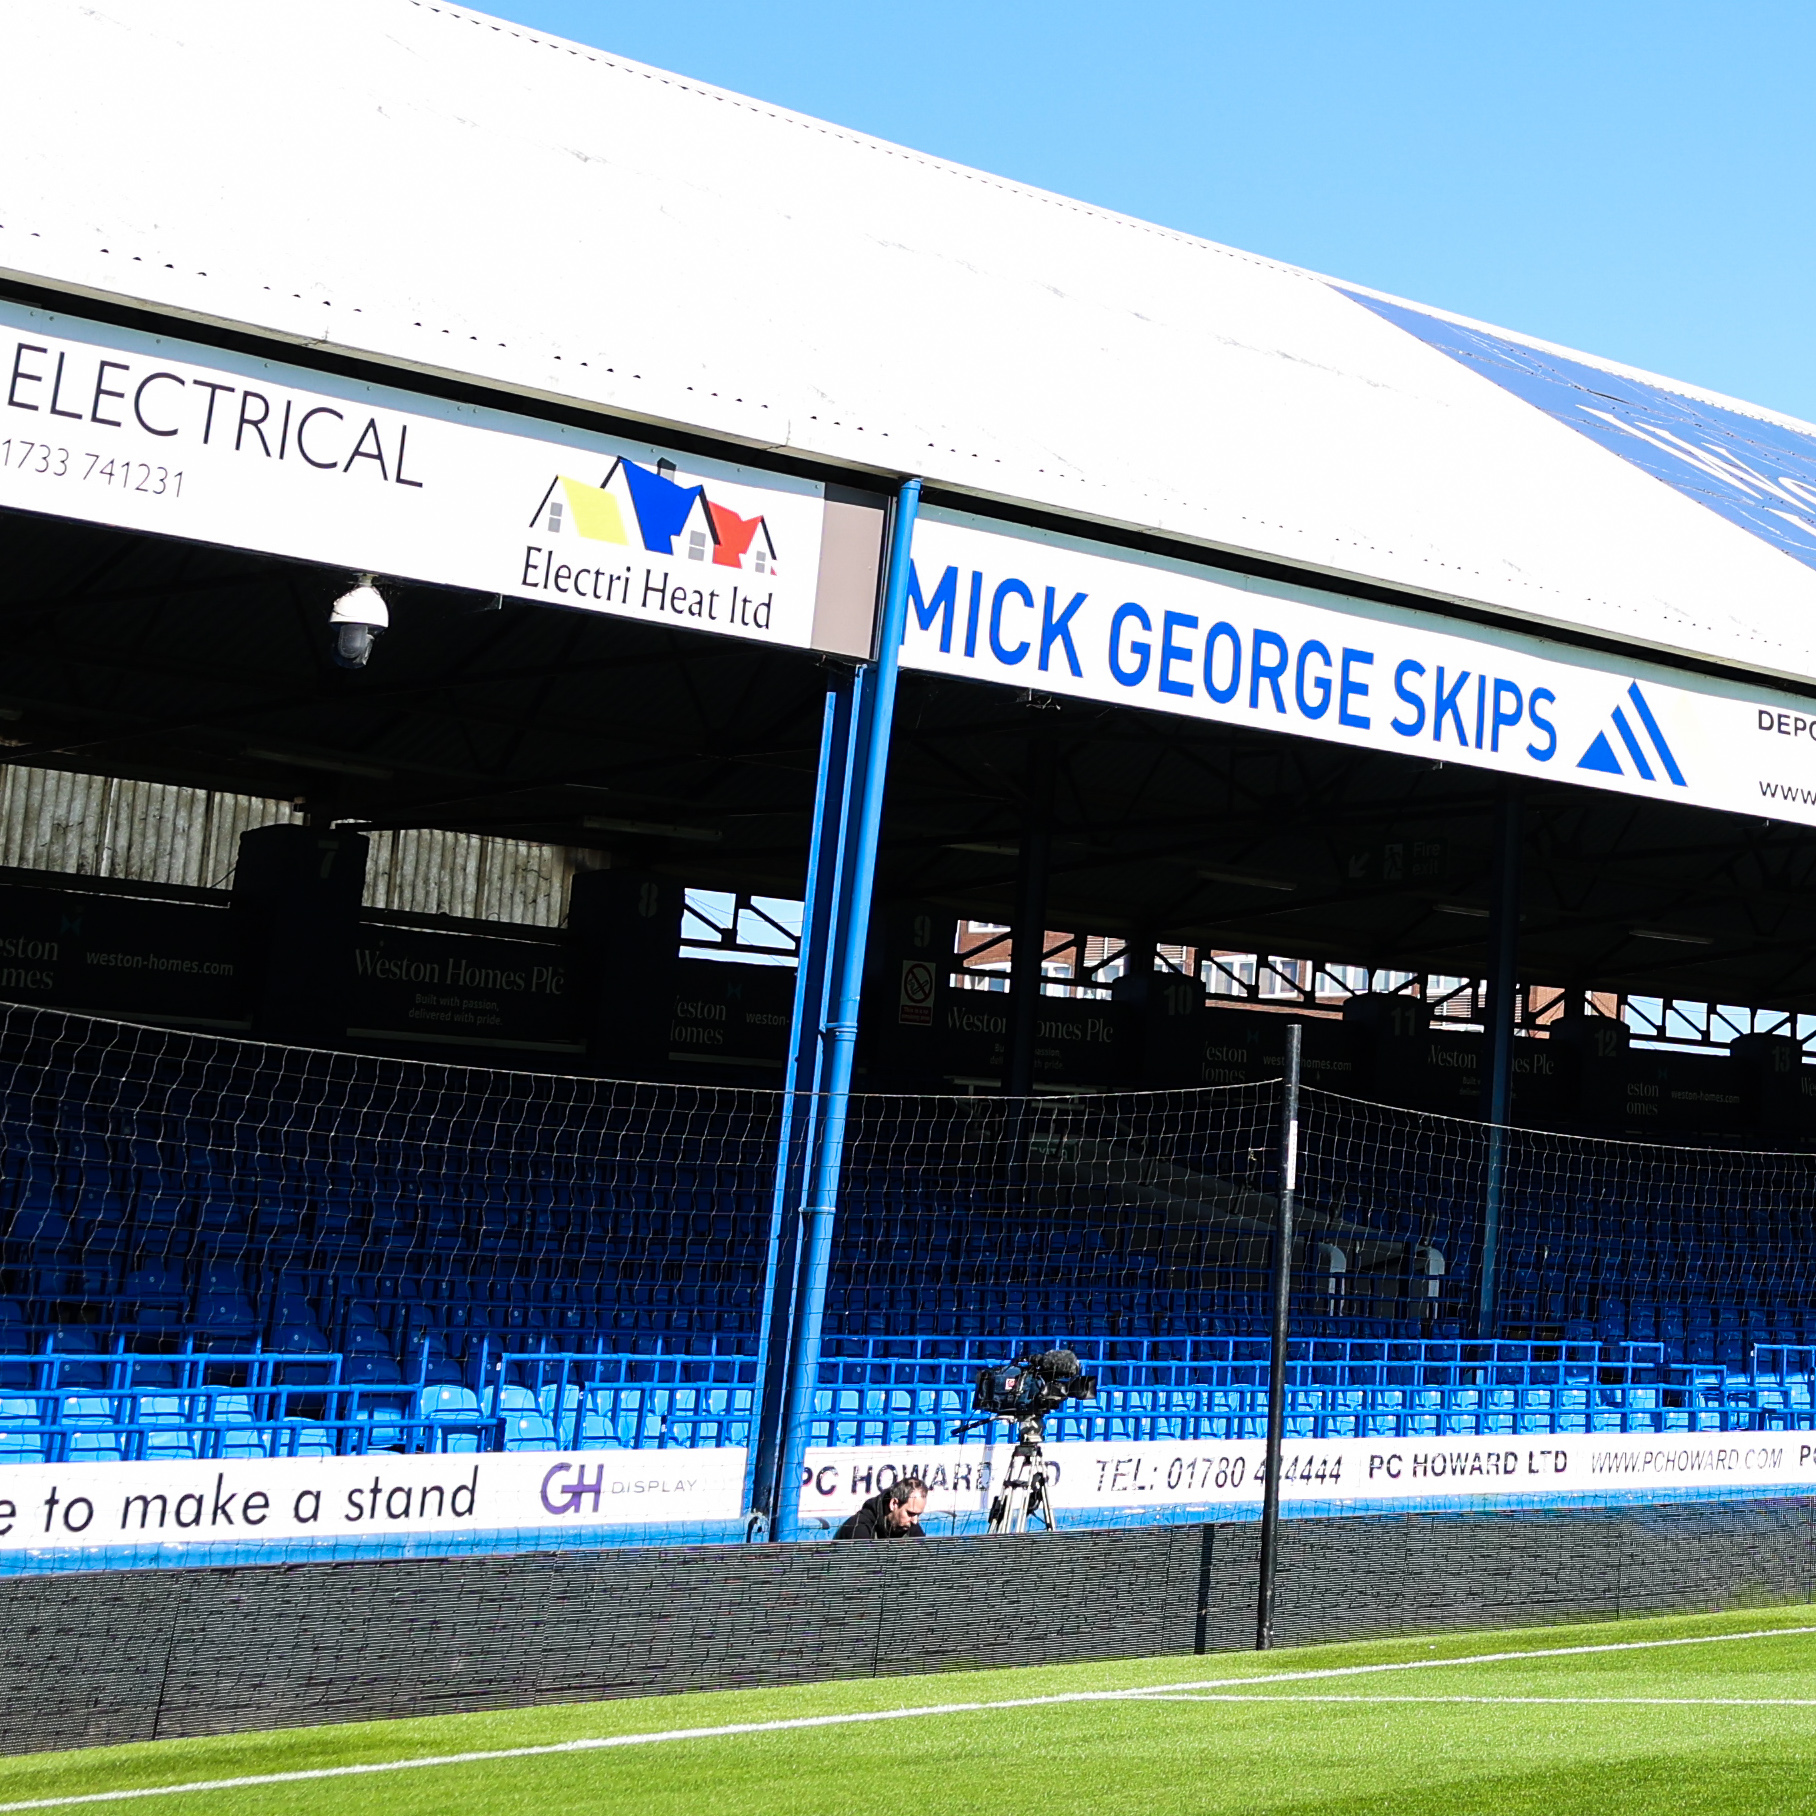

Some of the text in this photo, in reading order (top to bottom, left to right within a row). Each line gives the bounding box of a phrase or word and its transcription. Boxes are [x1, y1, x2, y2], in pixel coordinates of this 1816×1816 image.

[7, 342, 424, 489] ELECTRICAL
[83, 452, 183, 498] 741231
[521, 545, 773, 631] Electri Heat ltd
[900, 558, 1558, 762] MICK GEORGE SKIPS
[317, 839, 340, 880] 7
[638, 882, 659, 918] 8
[913, 915, 931, 947] 9
[86, 951, 234, 977] weston-homes.com
[354, 948, 565, 995] Weston Homes Plc
[1163, 984, 1194, 1016] 10
[1086, 1018, 1114, 1043] Plc
[1390, 1007, 1416, 1036] 11
[1594, 1029, 1617, 1057] 12
[1772, 1045, 1791, 1072] 13
[1533, 1054, 1554, 1075] Plc
[540, 1462, 697, 1516] GH DISPLAY
[802, 1466, 839, 1496] PC
[851, 1461, 992, 1495] HOWARD
[1096, 1459, 1158, 1492] TEL:
[1167, 1455, 1245, 1490] 01780
[1254, 1454, 1342, 1486] 44444
[1368, 1453, 1403, 1479] PC
[1412, 1451, 1518, 1478] HOWARD
[1527, 1450, 1567, 1475] LTD
[1592, 1448, 1783, 1475] WWW.PCHOWARD.COM
[44, 1465, 479, 1533] to make a stand
